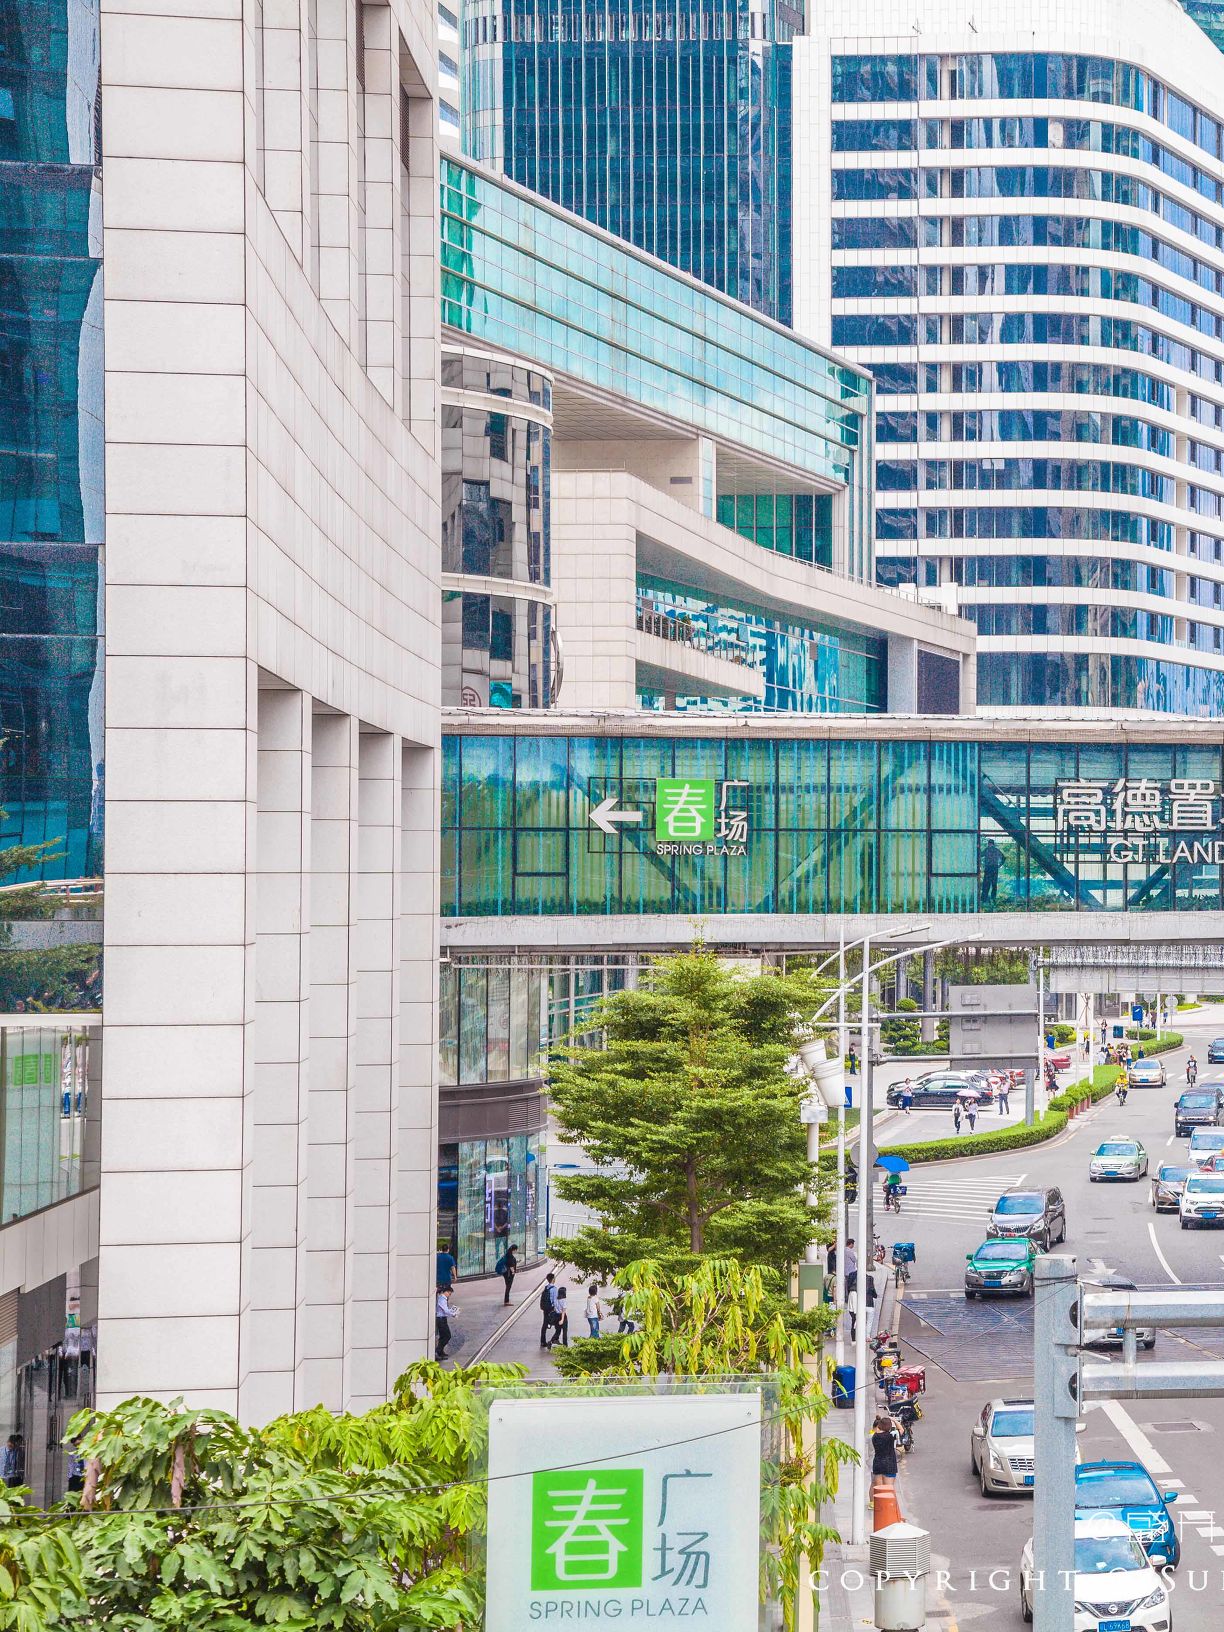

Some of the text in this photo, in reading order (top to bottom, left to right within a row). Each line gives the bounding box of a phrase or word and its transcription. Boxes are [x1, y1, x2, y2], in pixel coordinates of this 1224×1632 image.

[663, 783, 707, 837] 春
[656, 844, 747, 856] SPRING PLAZA
[1110, 839, 1150, 864] GT
[544, 1478, 630, 1582] 春
[529, 1597, 708, 1620] SPRING PLAZA
